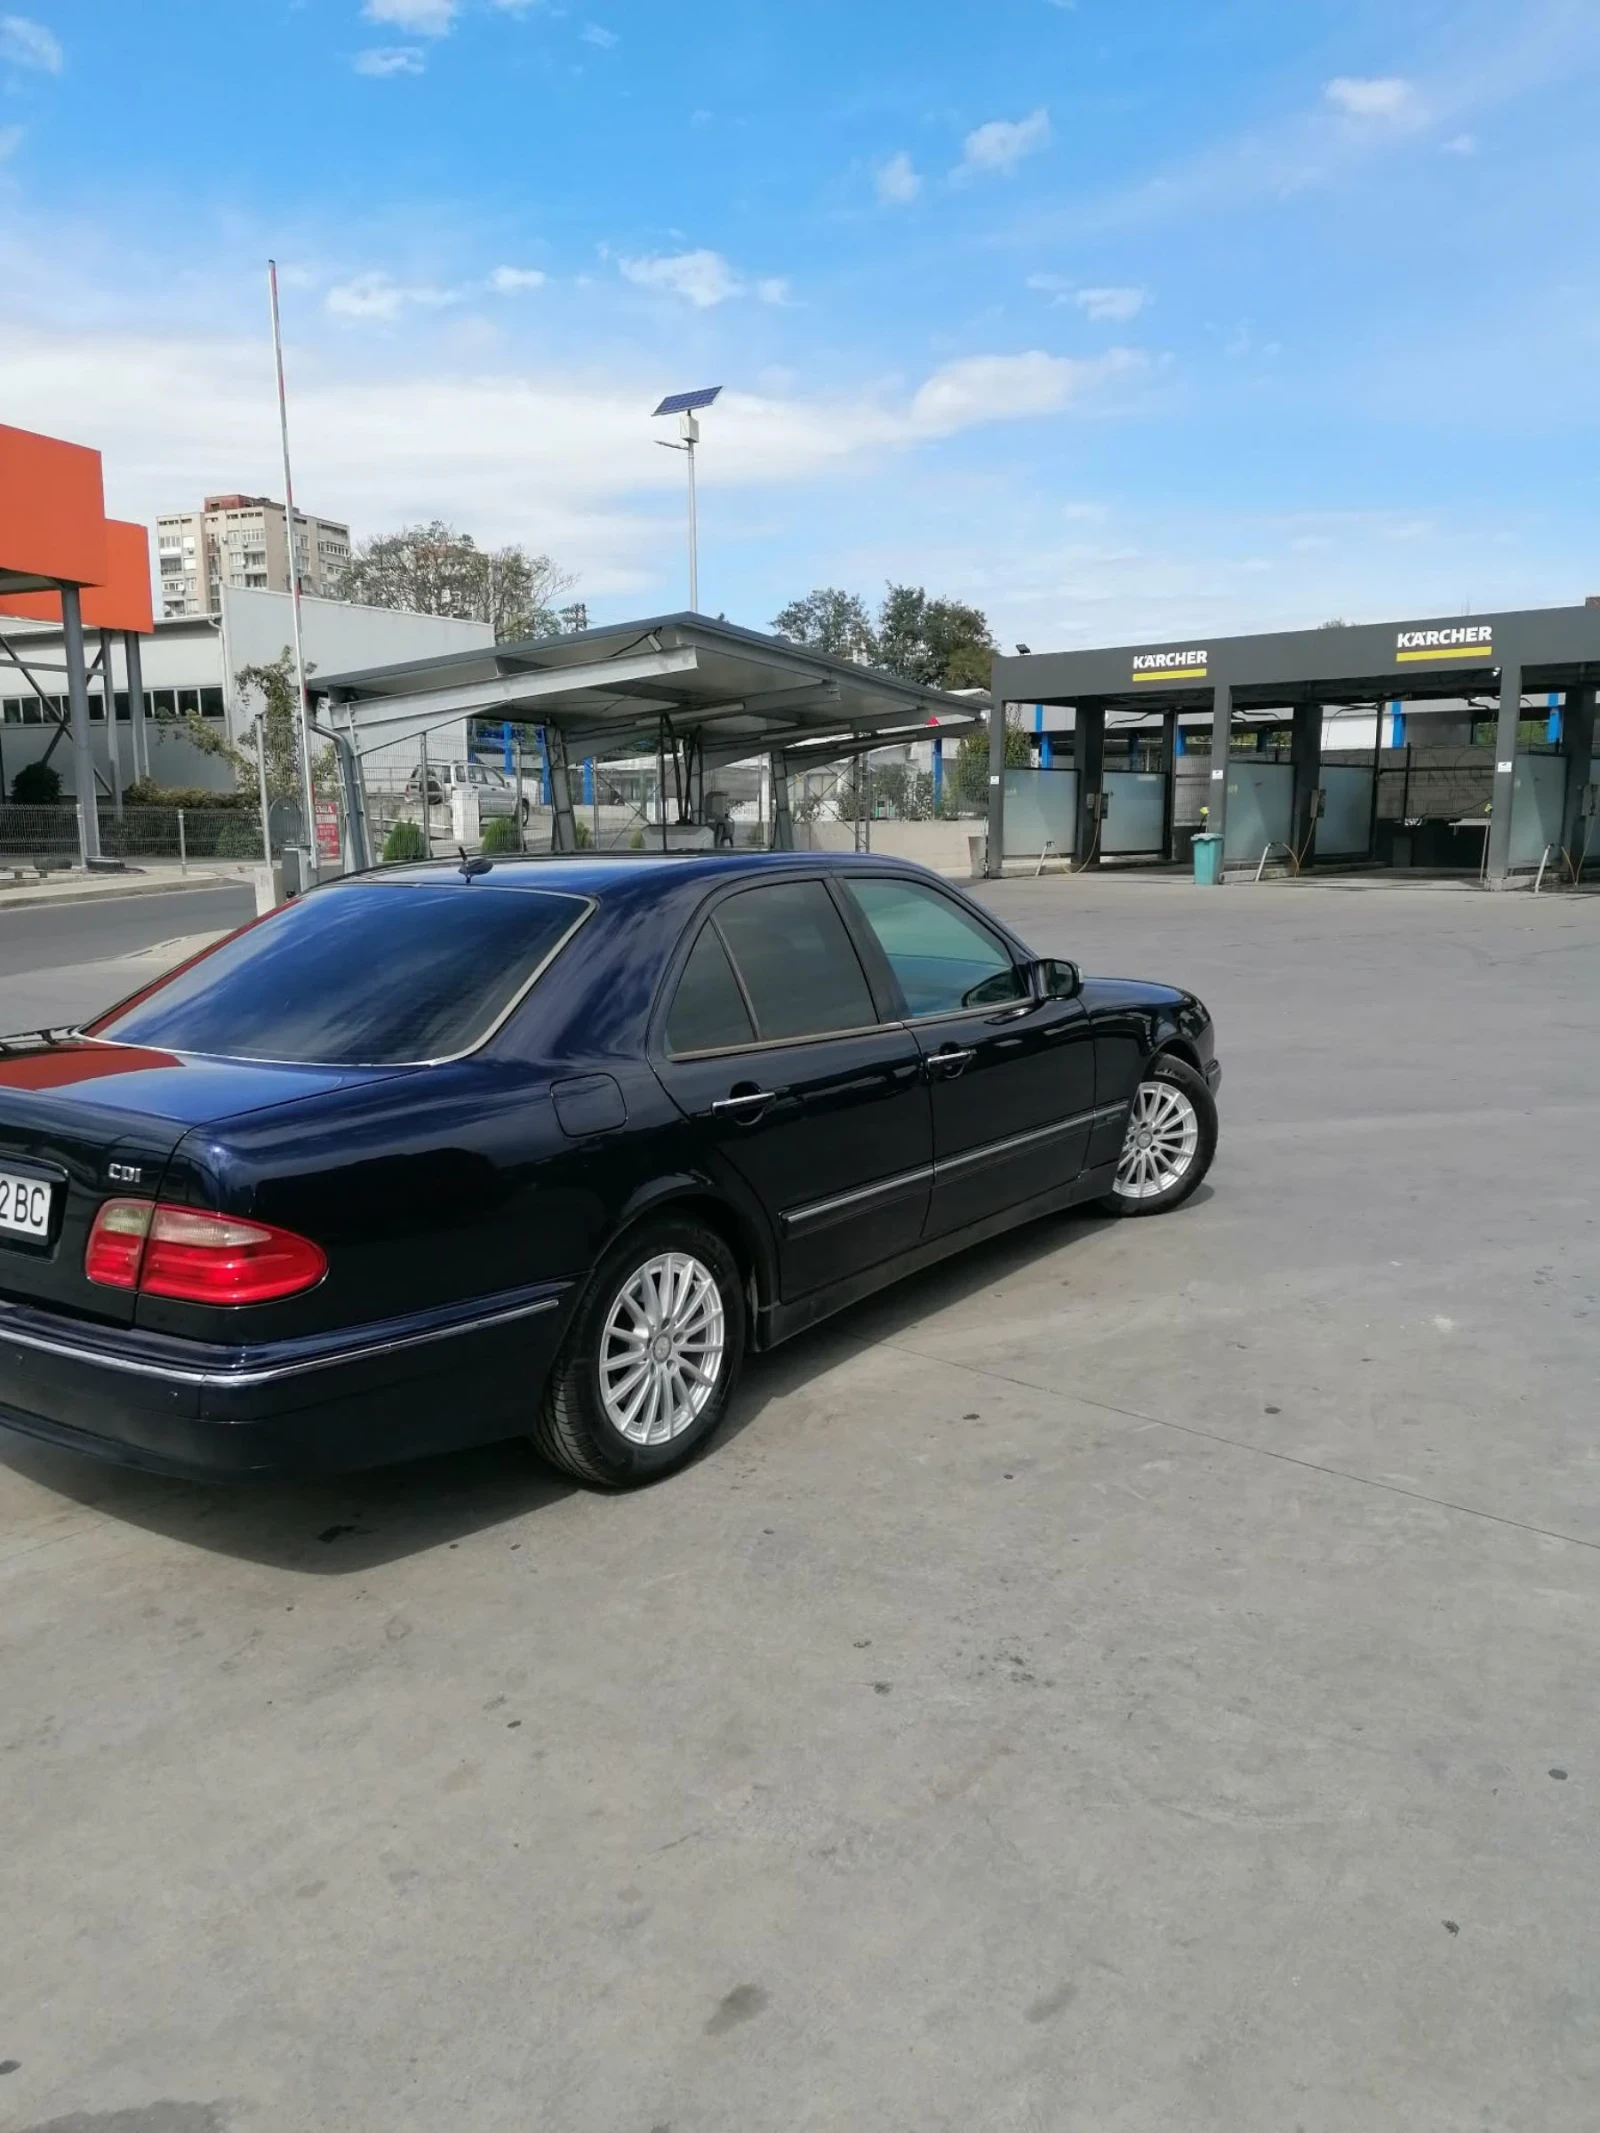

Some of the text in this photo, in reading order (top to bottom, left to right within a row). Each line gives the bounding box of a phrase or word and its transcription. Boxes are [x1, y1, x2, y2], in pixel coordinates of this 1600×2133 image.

[1396, 626, 1492, 648] KÄRCHER
[1133, 650, 1208, 669] KÄRCHER
[108, 1163, 141, 1183] CDI
